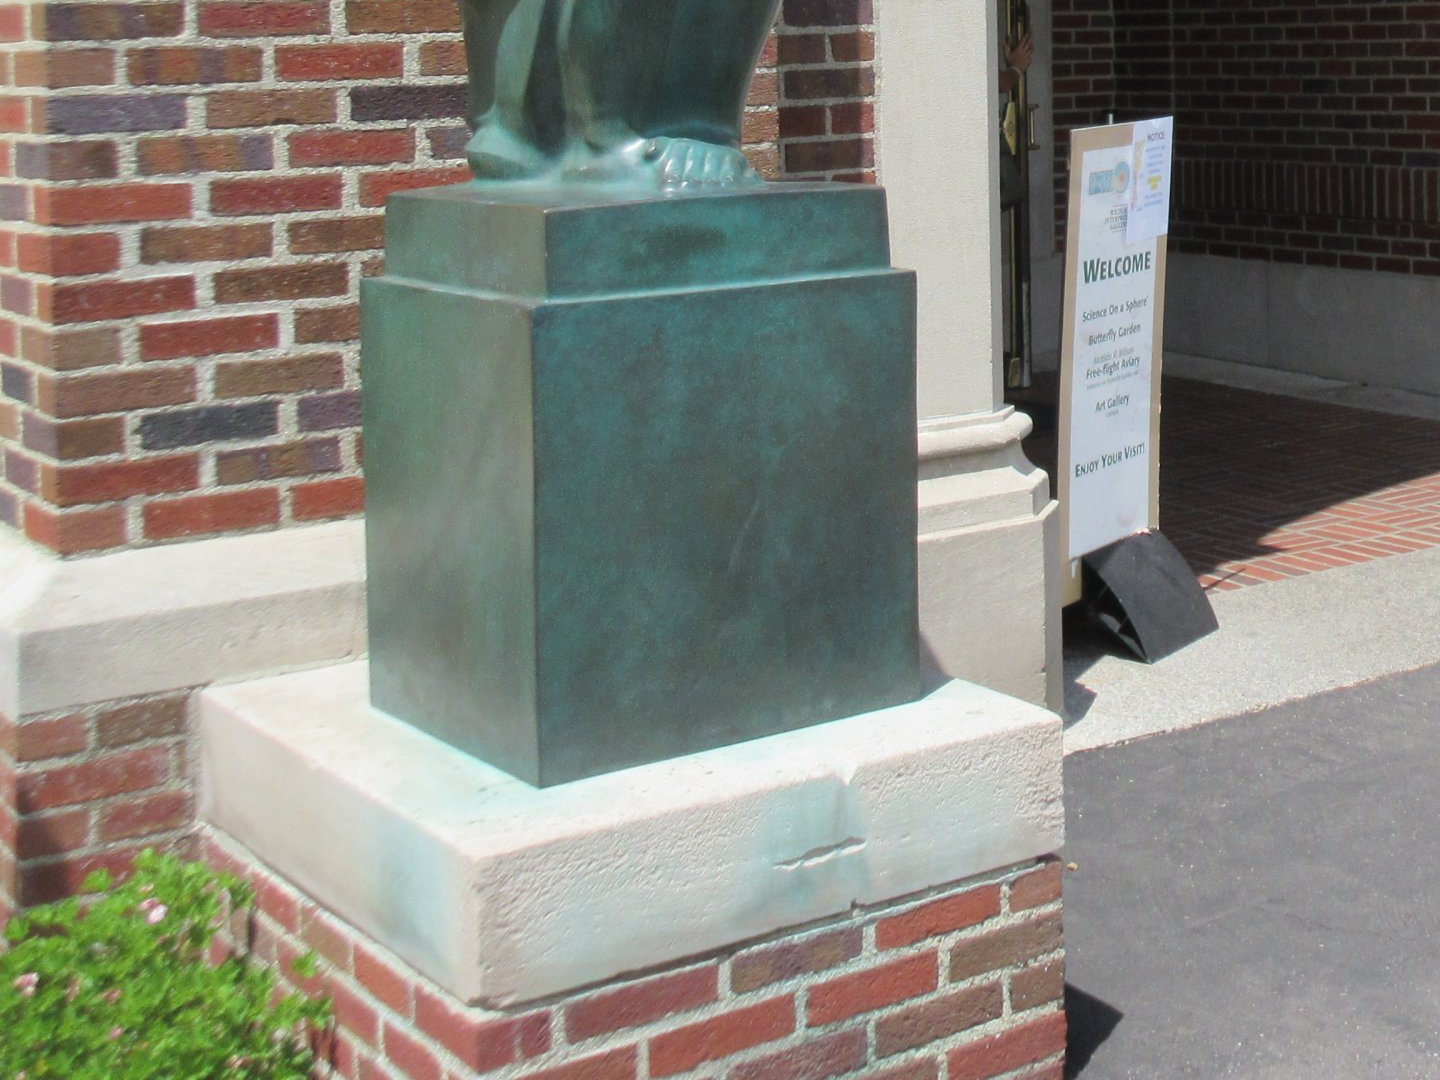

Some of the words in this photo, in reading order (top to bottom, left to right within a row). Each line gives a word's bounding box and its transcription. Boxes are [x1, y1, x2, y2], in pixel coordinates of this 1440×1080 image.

[1083, 251, 1151, 284] WELCOME
[1082, 309, 1107, 322] Science
[1109, 305, 1118, 315] On
[1088, 328, 1117, 346] Butterfly
[1118, 323, 1141, 337] Garden
[1086, 362, 1120, 380] Free-flight
[1121, 356, 1141, 370] Aviary
[1095, 401, 1106, 413] Art
[1107, 394, 1129, 410] Gallery
[1075, 460, 1099, 477] ENJOY
[1101, 452, 1122, 468] YOUR
[1124, 442, 1145, 460] VISIT!
